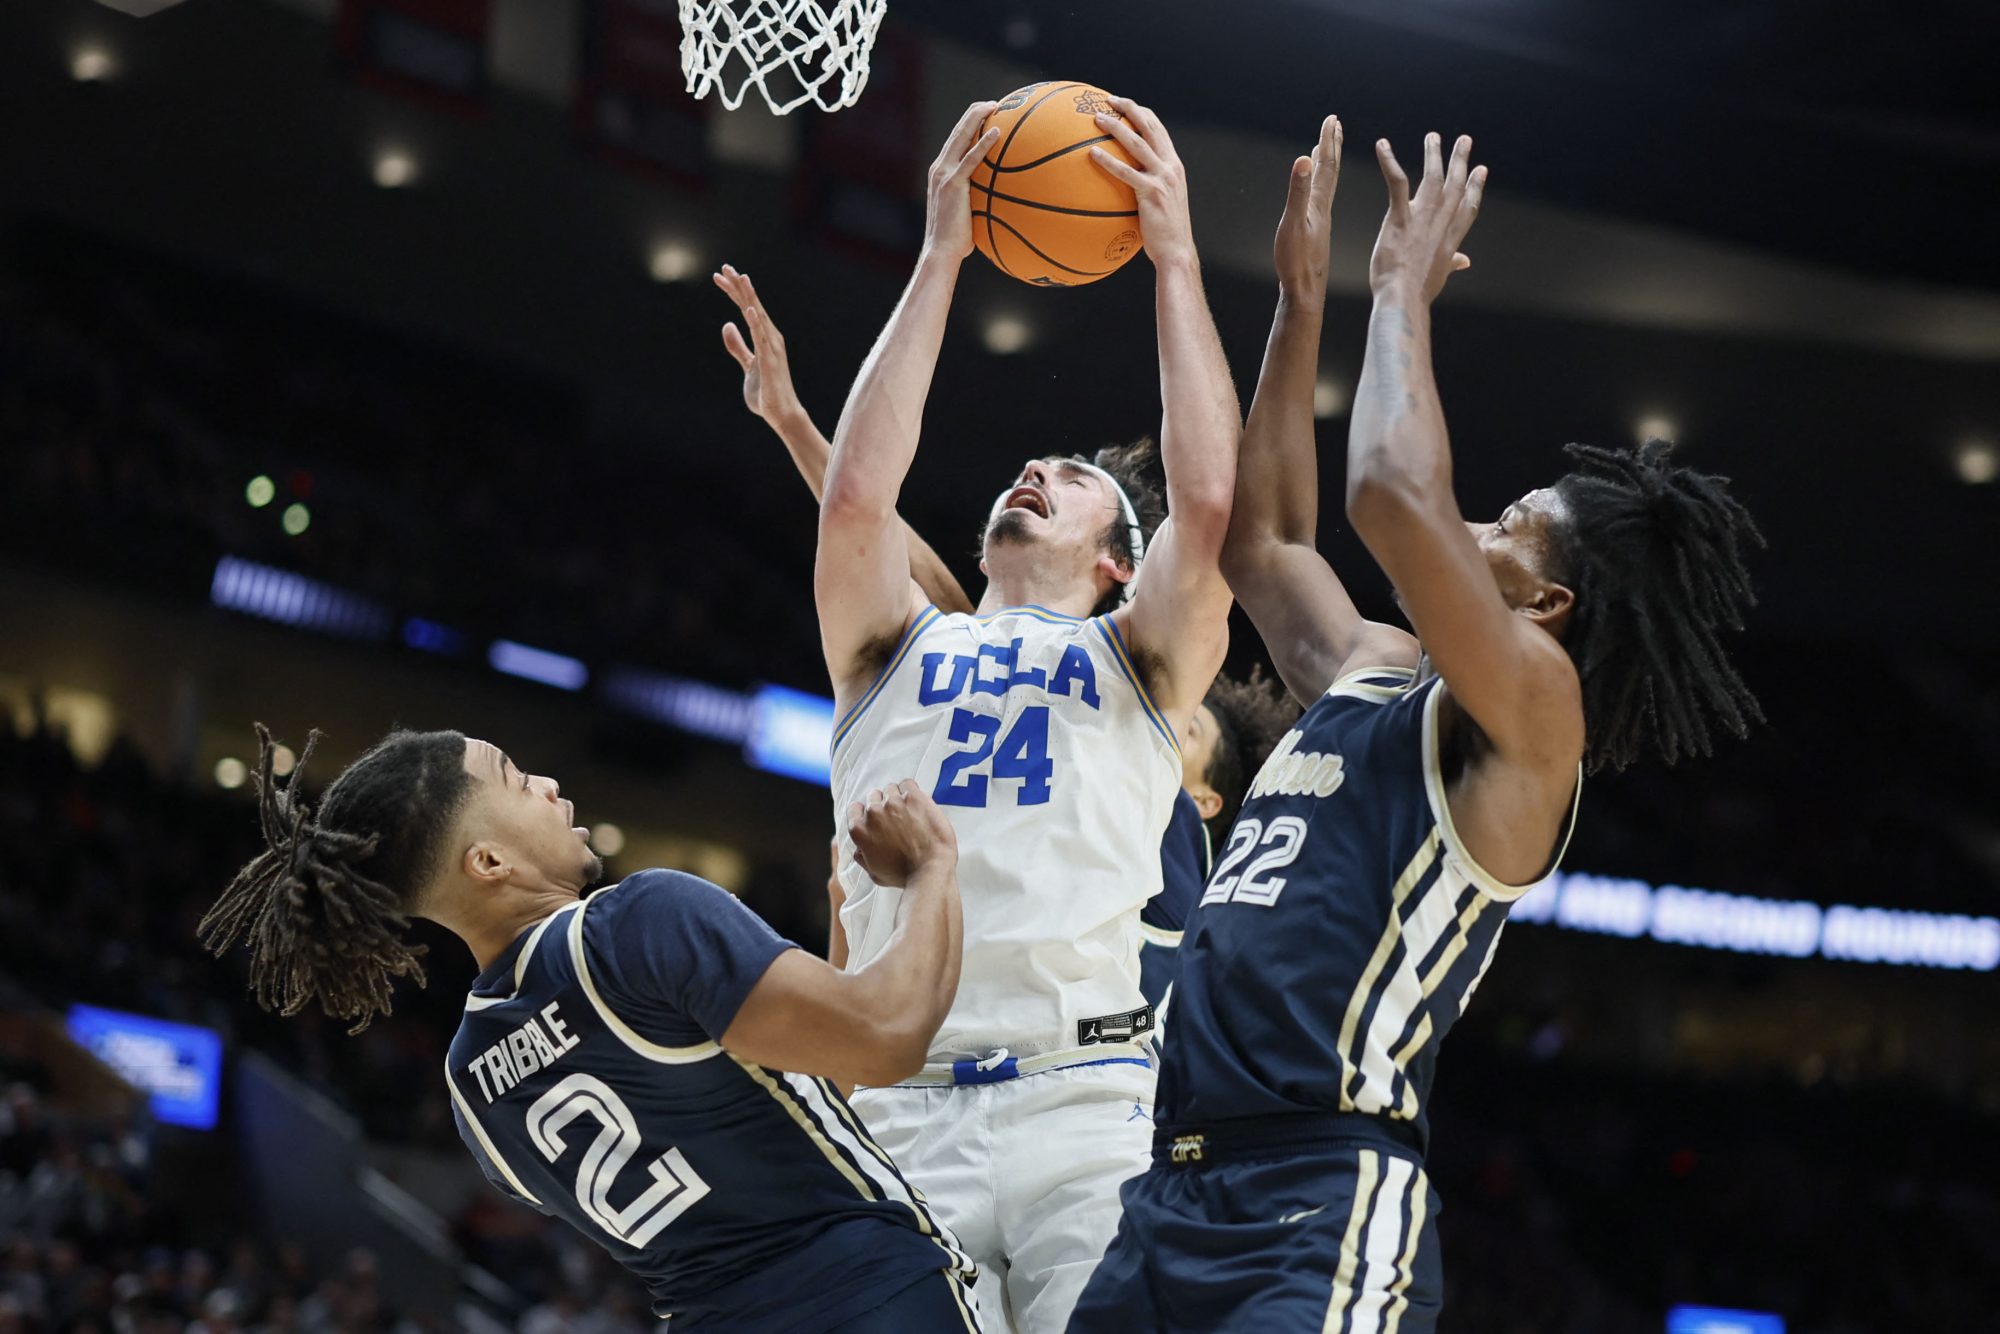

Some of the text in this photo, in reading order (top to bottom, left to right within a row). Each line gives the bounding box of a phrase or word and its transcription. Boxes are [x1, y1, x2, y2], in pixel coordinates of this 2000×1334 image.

[918, 637, 1101, 711] UCLA
[932, 706, 1053, 808] 24
[1199, 816, 1308, 908] 22
[468, 1001, 581, 1104] TRIBBLE
[1136, 1015, 1147, 1028] 48
[526, 1073, 712, 1249] 2
[1172, 1135, 1205, 1162] ZIPS
